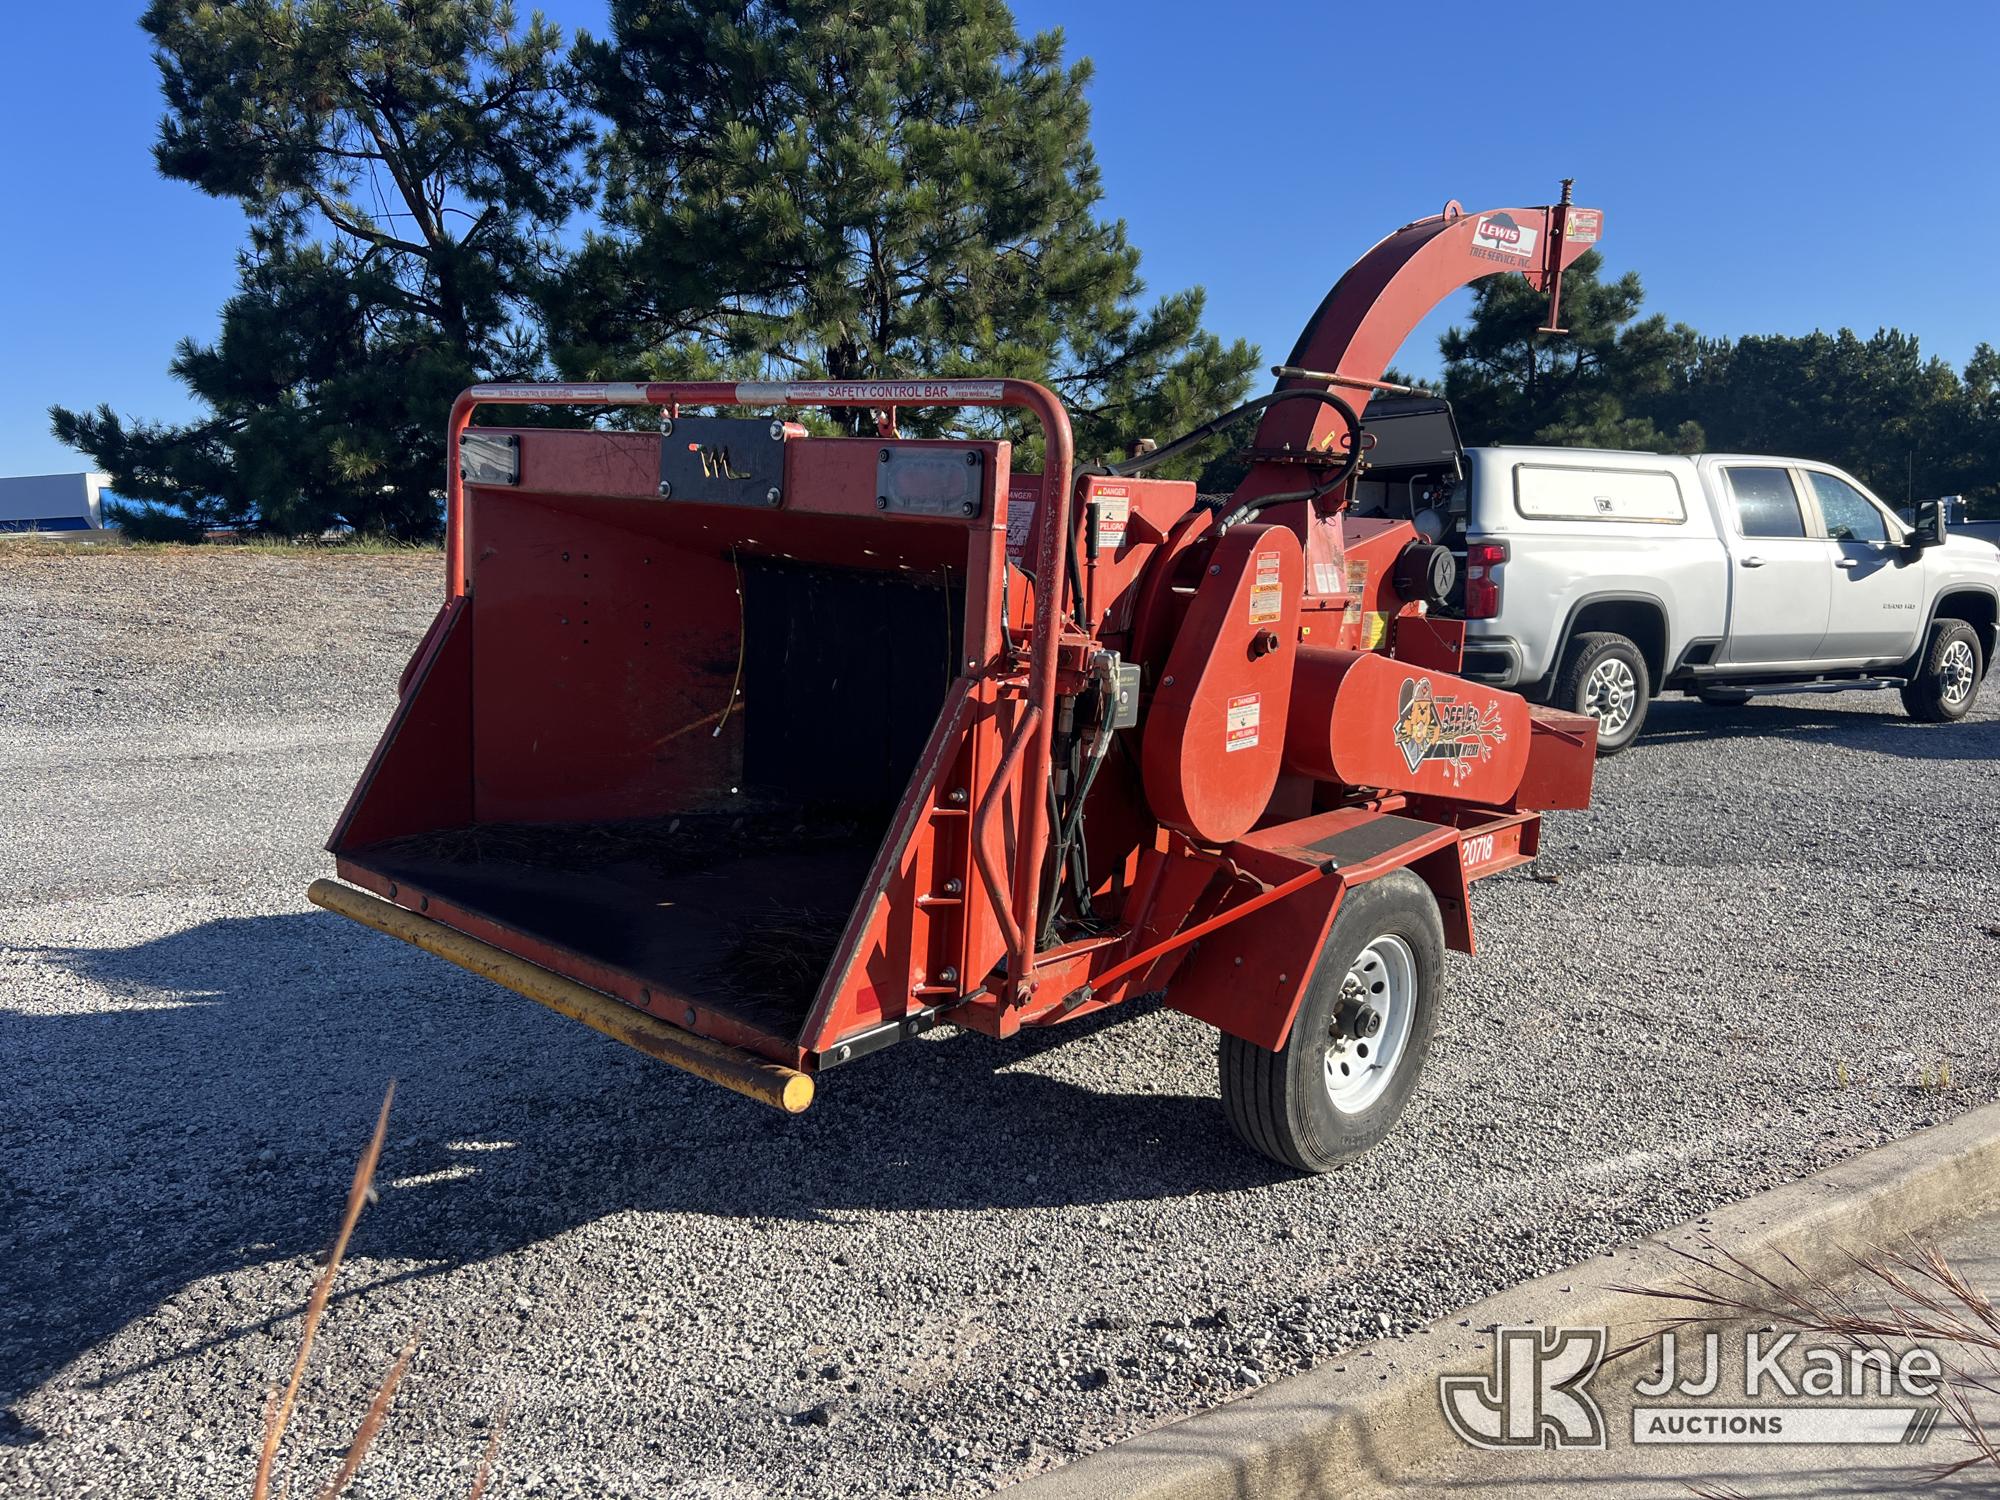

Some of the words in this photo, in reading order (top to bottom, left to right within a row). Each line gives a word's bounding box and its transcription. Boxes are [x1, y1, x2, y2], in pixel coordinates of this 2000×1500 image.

[1480, 222, 1519, 242] LEWIS
[1470, 246, 1487, 260] TREE
[828, 387, 867, 398] SAFETY
[869, 386, 922, 398] CONTROL
[924, 385, 949, 398] BAR
[1009, 491, 1033, 500] ANGER
[1103, 487, 1126, 496] DANGER
[1099, 522, 1124, 531] PELIGRO
[1462, 834, 1493, 867] 20718
